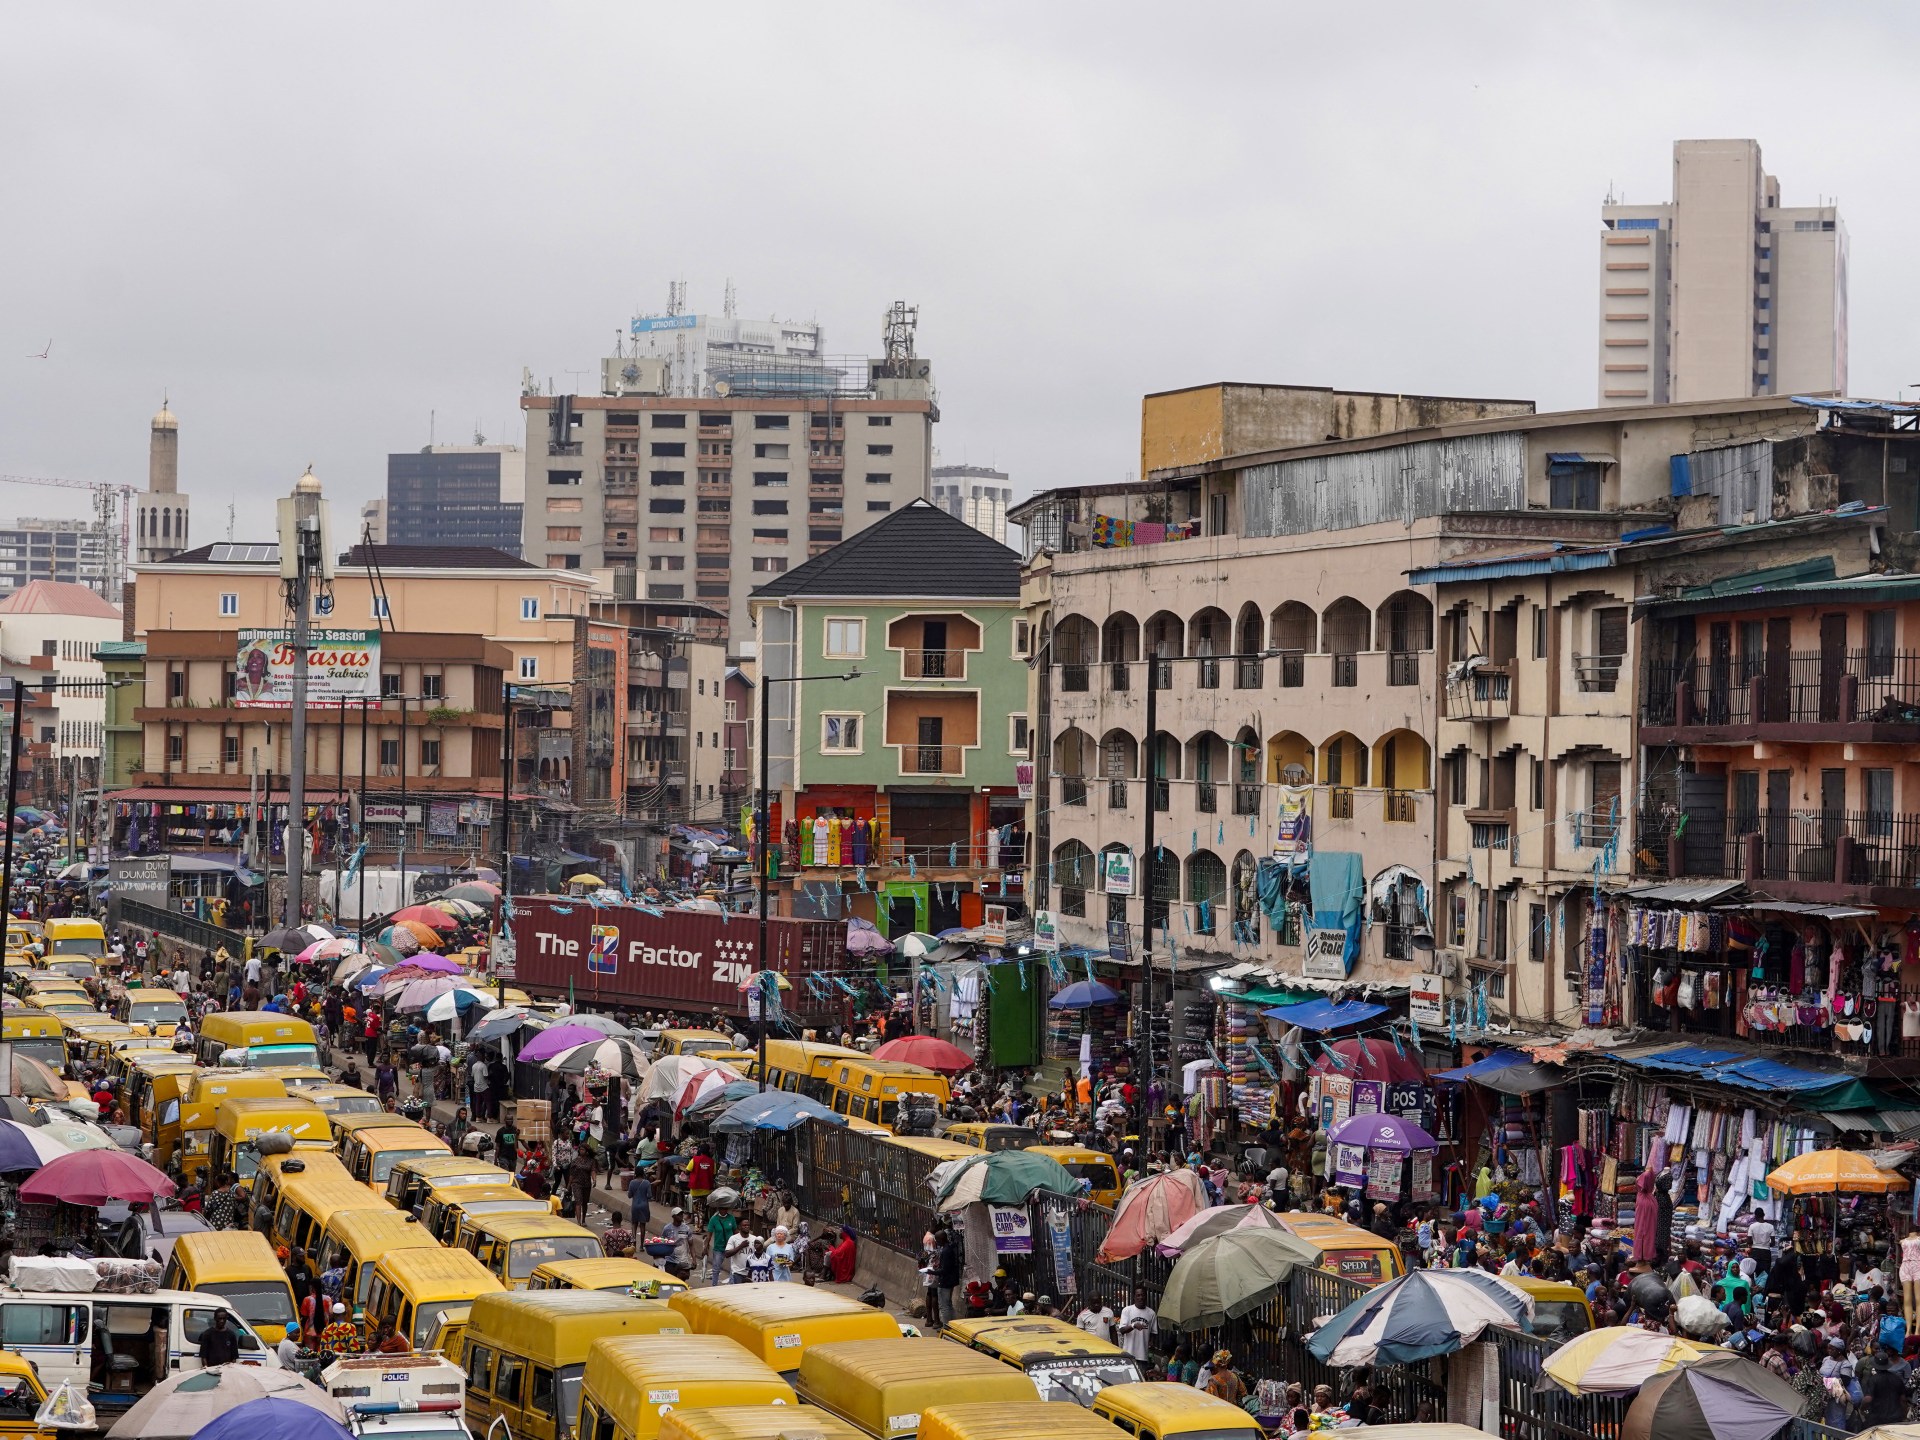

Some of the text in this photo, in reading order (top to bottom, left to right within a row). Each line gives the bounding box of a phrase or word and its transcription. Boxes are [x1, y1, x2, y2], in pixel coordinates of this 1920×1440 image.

[325, 630, 366, 641] Season
[326, 667, 369, 679] Fabrics
[119, 870, 157, 879] IDUMOTA
[535, 932, 580, 957] The
[628, 940, 703, 969] Factor
[1320, 941, 1344, 956] Gold
[712, 960, 752, 984] ZIM
[1329, 1081, 1350, 1095] POS
[1358, 1094, 1376, 1102] POS
[1392, 1091, 1417, 1107] POS
[1374, 1137, 1401, 1145] PalmPay
[1797, 1172, 1834, 1181] LONTOR
[1839, 1172, 1880, 1180] LONTOR
[995, 1212, 1012, 1223] ATM
[996, 1222, 1014, 1232] CARD
[1341, 1260, 1369, 1271] SPEDY
[383, 1373, 409, 1381] POLICE
